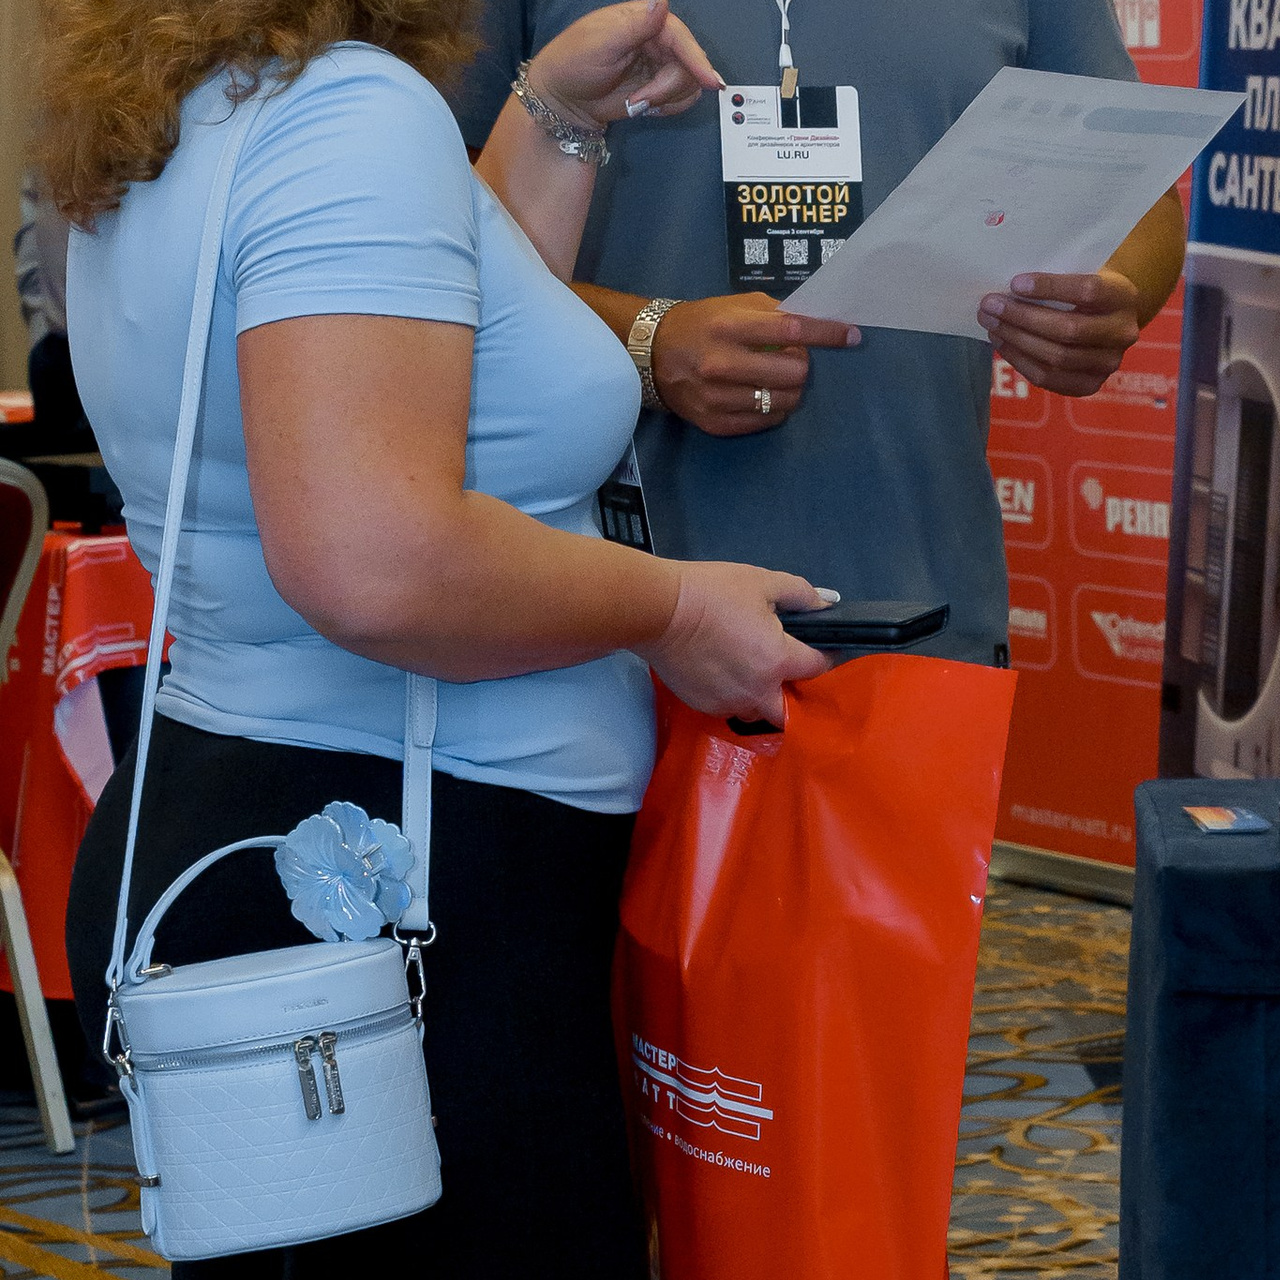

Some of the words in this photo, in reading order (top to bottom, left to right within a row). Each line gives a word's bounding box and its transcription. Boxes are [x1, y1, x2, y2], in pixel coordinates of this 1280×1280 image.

[777, 150, 810, 160] LU.RU
[737, 180, 850, 204] ЗОЛОТОЙ
[741, 204, 848, 223] ПАРТНЕР
[632, 1032, 677, 1071] МАСТЕР
[674, 1134, 772, 1179] водоснабжение
